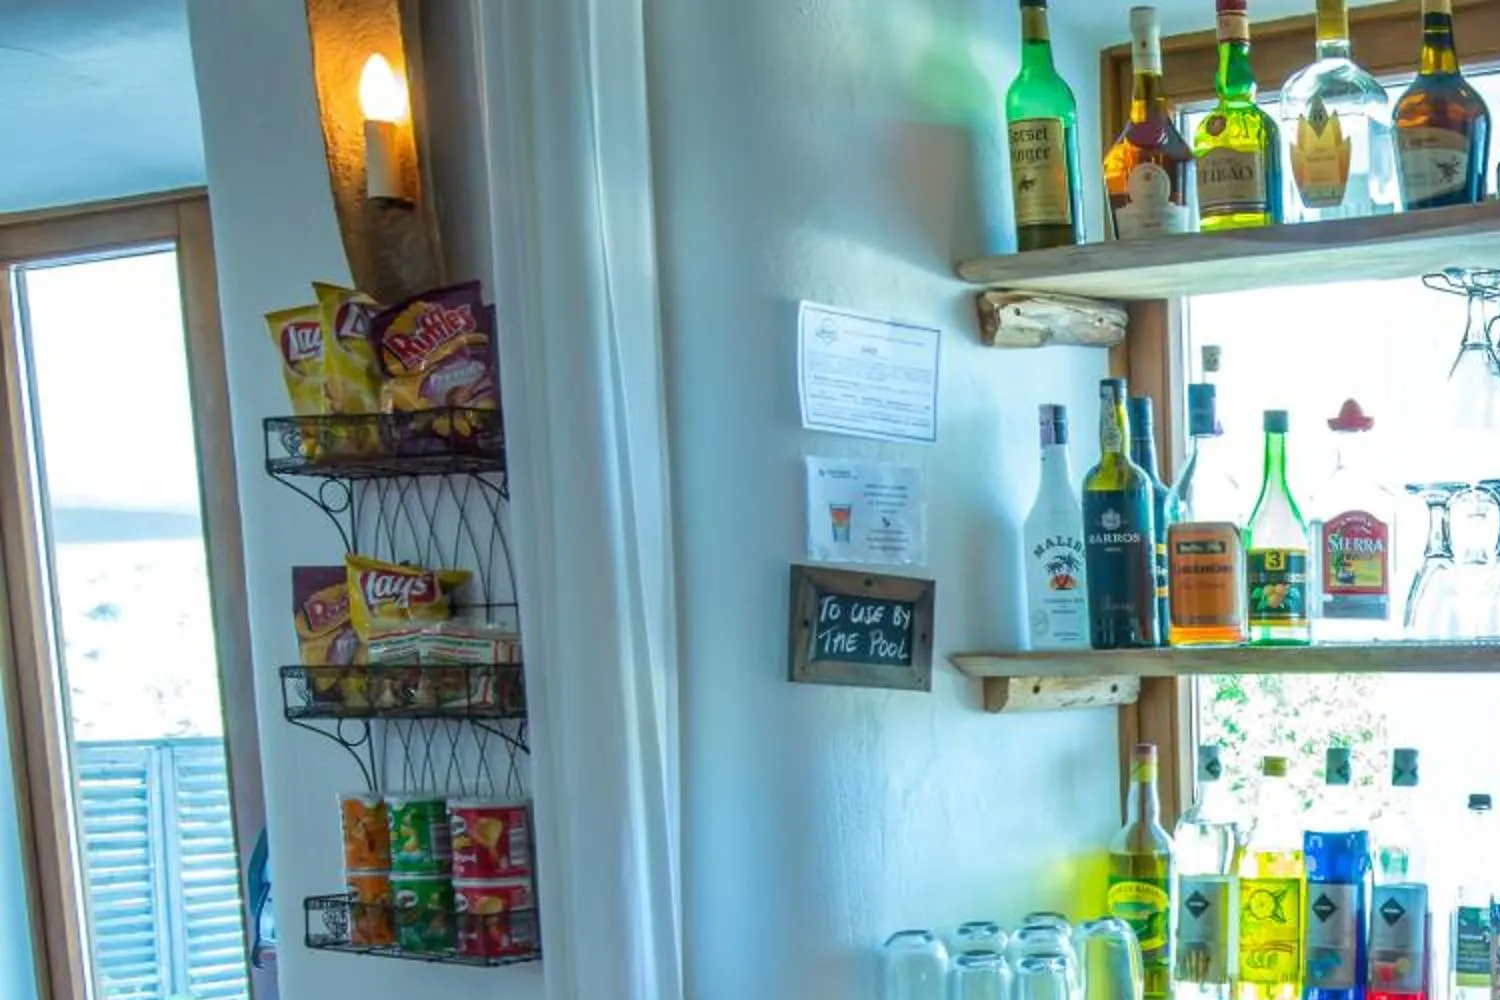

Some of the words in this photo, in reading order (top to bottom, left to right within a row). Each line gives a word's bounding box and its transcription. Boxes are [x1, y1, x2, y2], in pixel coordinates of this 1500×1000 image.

[382, 302, 478, 369] Ruffles
[1033, 535, 1086, 558] MALIB
[1266, 551, 1281, 568] 3
[820, 595, 841, 623] TO
[850, 602, 885, 625] USE
[893, 604, 911, 630] BY
[817, 625, 860, 654] THE
[868, 628, 908, 660] POOL
